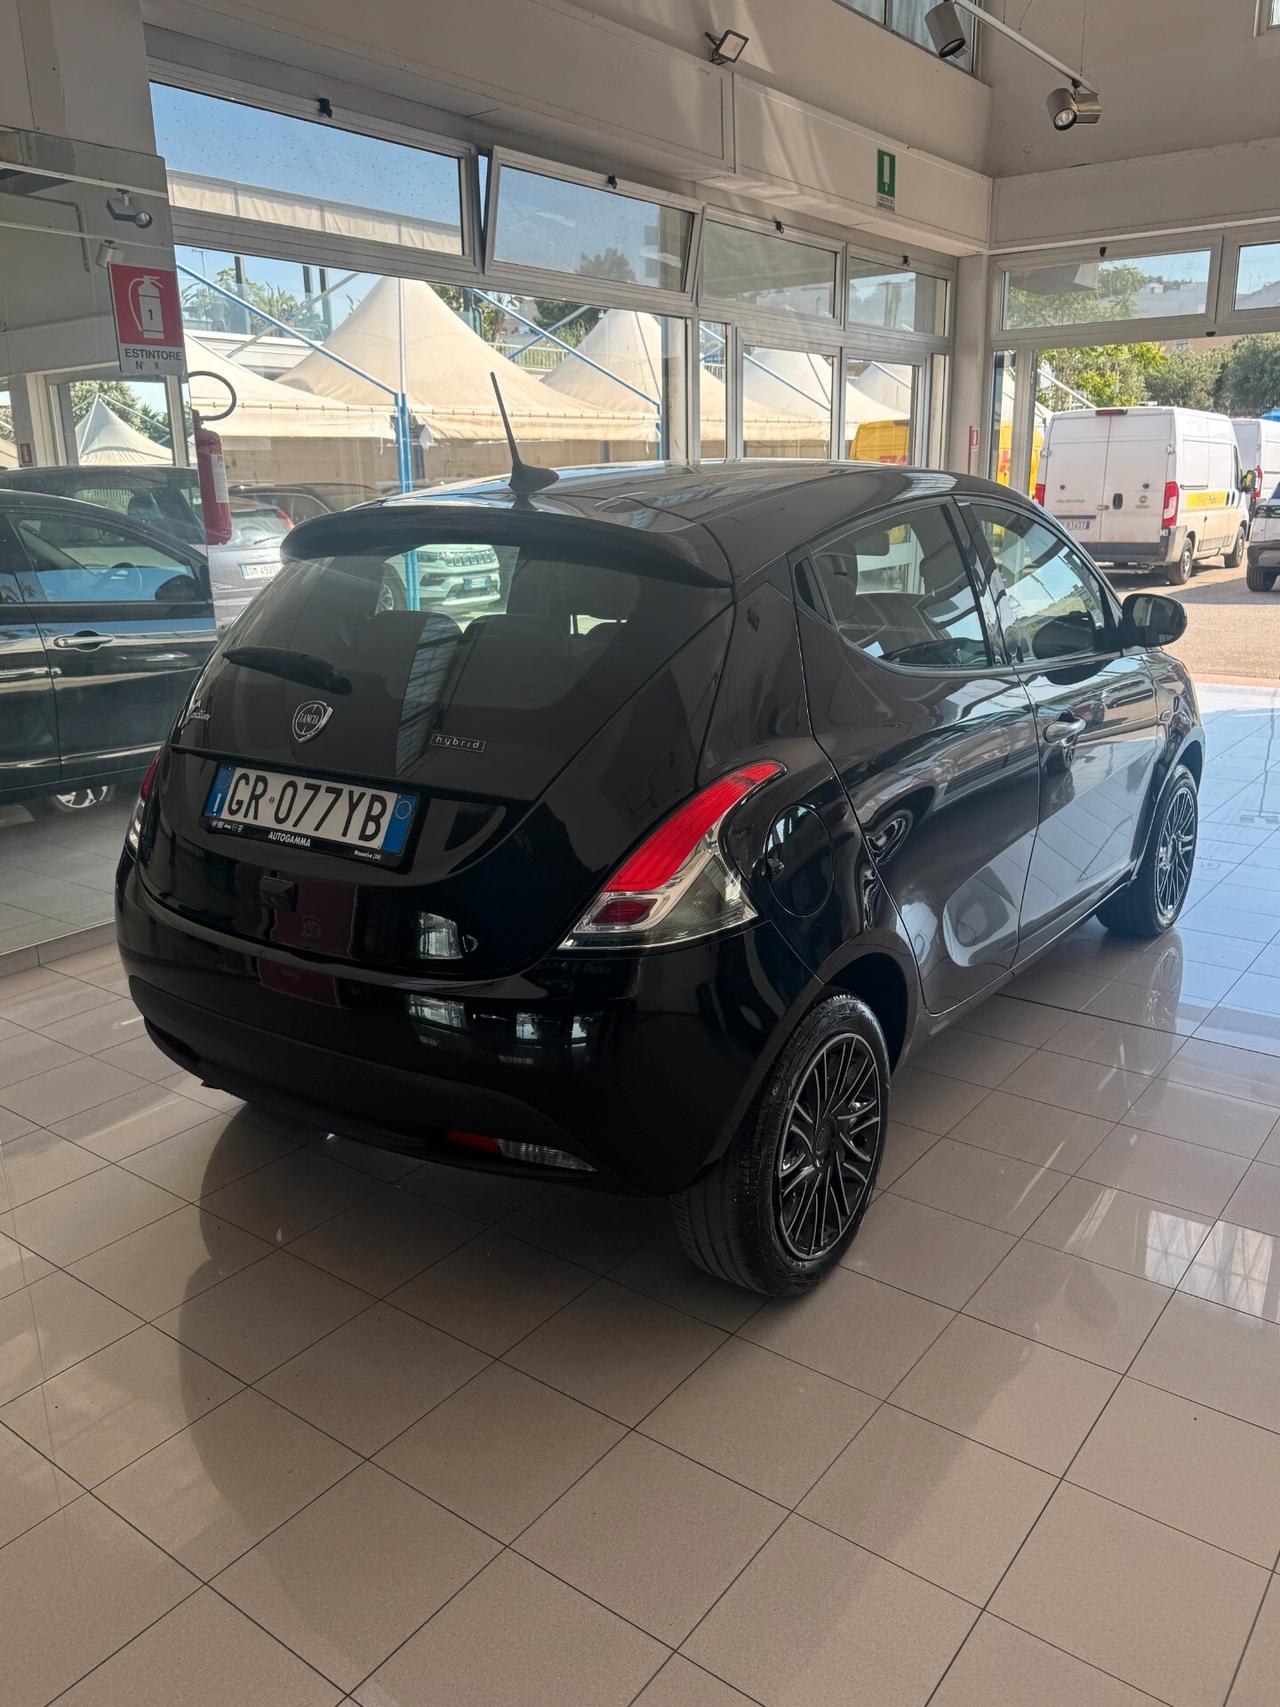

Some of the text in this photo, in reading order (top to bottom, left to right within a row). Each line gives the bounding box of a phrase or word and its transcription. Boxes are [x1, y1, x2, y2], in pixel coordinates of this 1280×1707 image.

[148, 309, 153, 320] 1
[125, 348, 182, 360] ESTINTORE
[435, 735, 480, 749] hybrid
[227, 772, 268, 820] GR
[274, 780, 388, 842] 077YB
[268, 831, 311, 847] AUTOGAMMA
